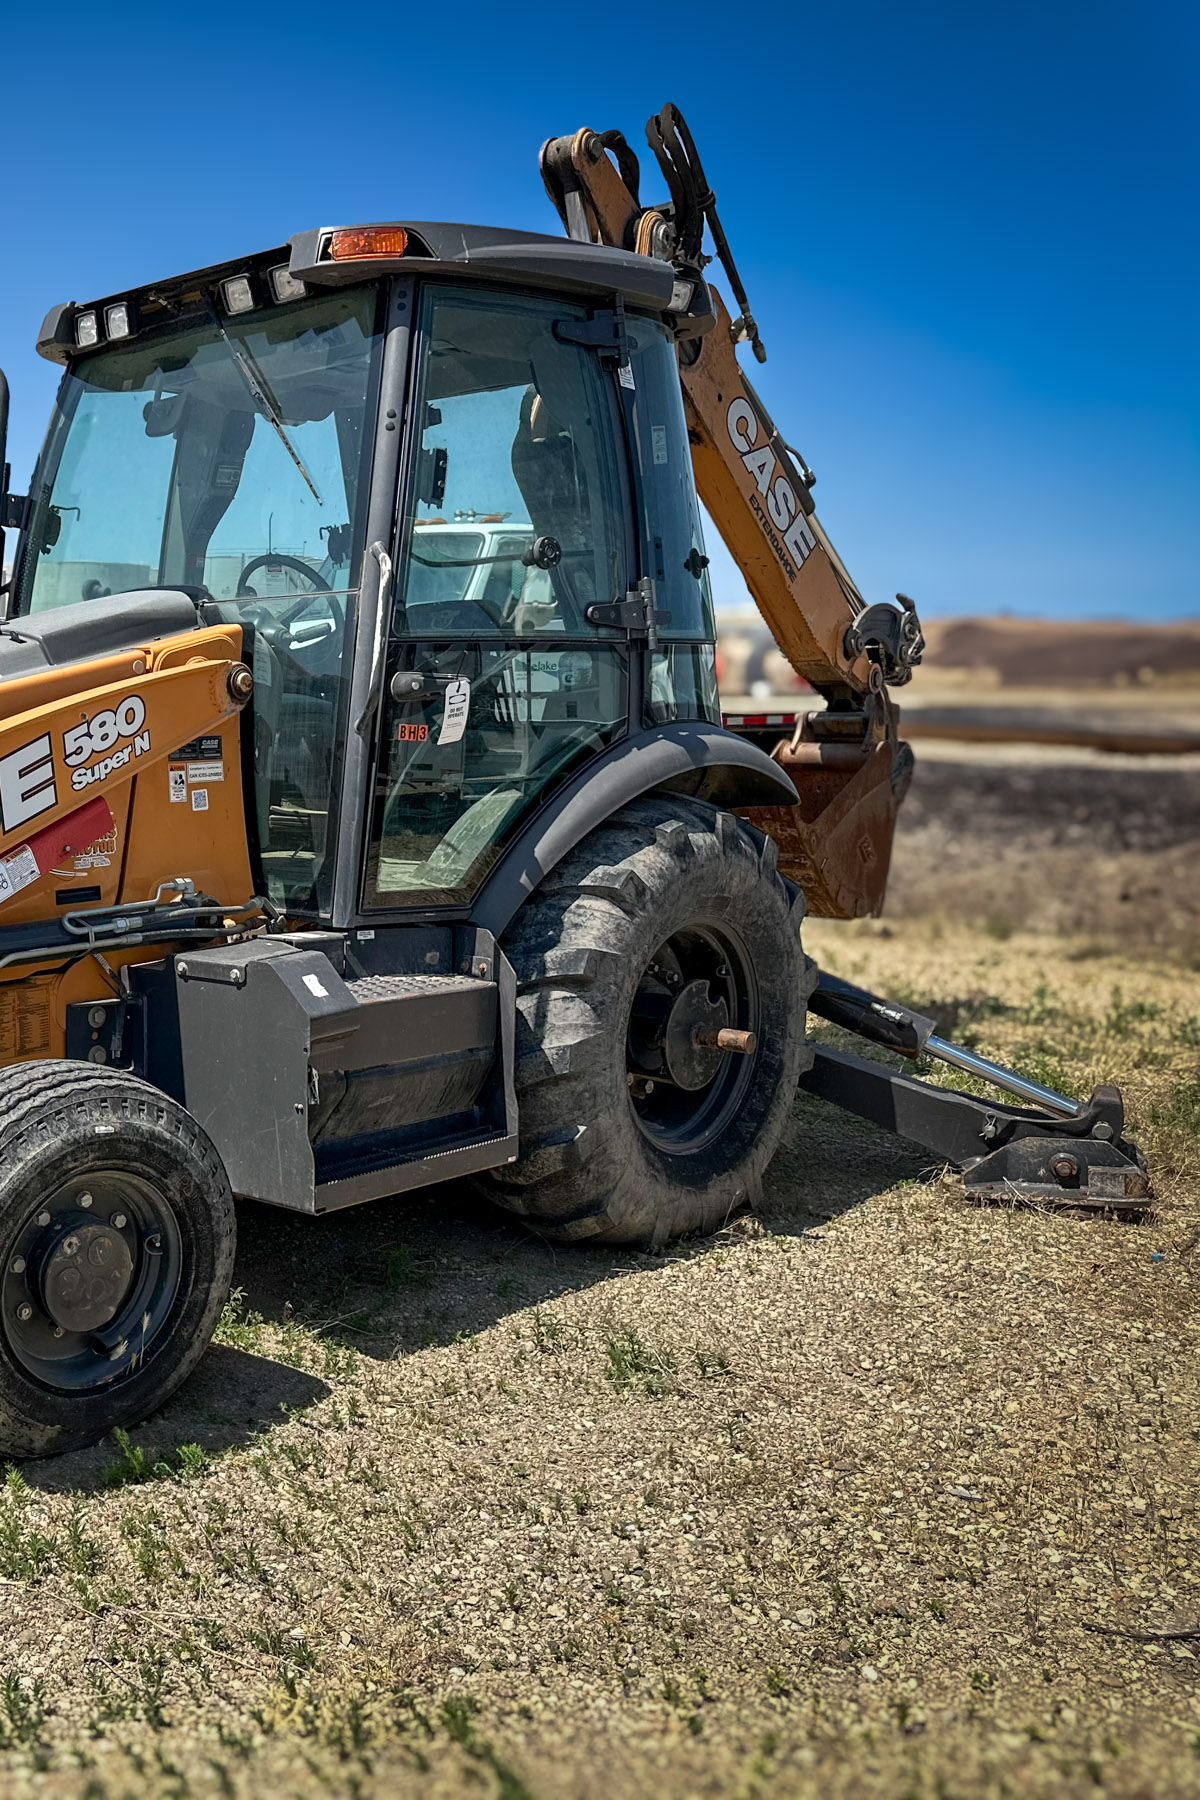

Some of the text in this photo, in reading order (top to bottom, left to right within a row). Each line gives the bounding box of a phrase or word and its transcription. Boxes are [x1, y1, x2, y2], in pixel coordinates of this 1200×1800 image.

[726, 396, 818, 571] CASE
[749, 493, 798, 584] EXTENDAHOE
[62, 694, 147, 767] 580
[71, 743, 133, 792] Super
[133, 729, 152, 758] N
[400, 724, 427, 740] BH3
